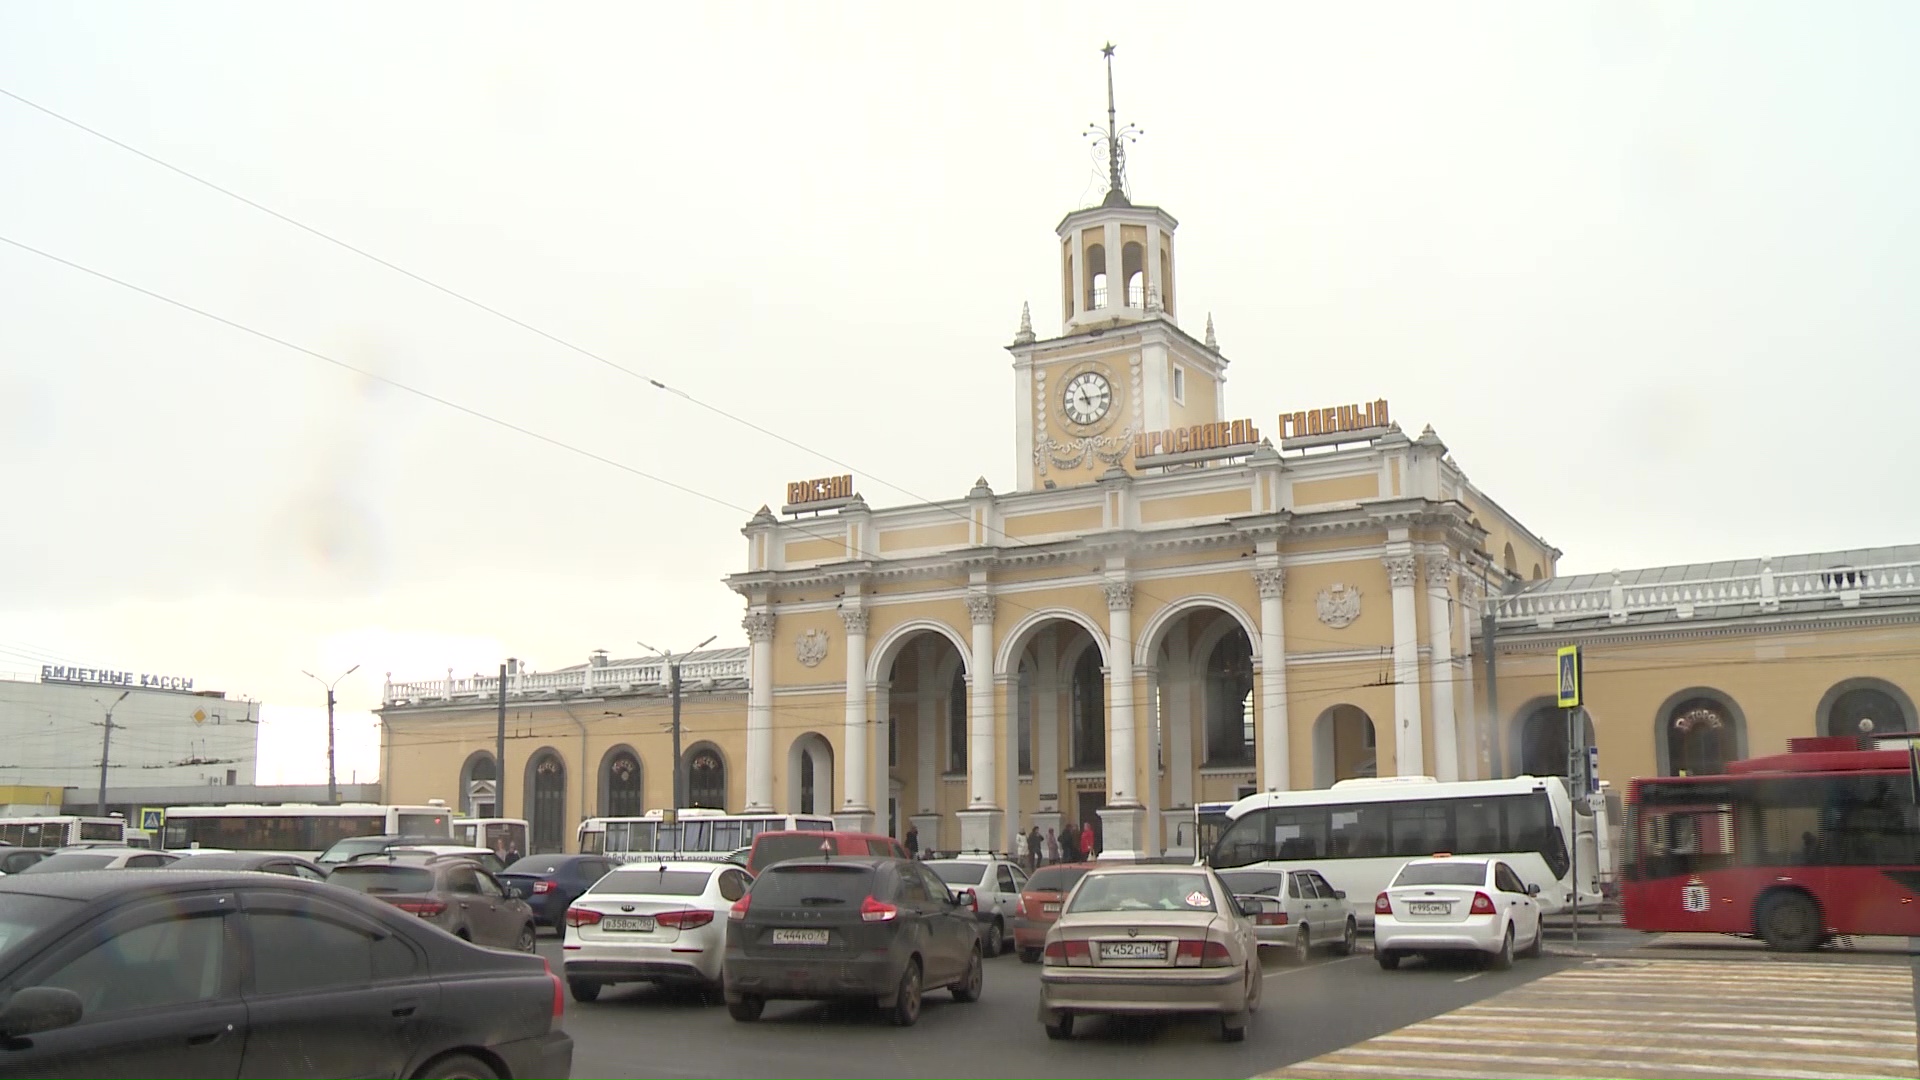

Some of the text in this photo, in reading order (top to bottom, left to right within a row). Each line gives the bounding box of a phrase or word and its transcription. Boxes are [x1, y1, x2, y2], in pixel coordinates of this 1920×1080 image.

[1134, 400, 1389, 459] ЯРОСЛАВЛЬ ГЛАВНЫЙ
[787, 474, 853, 505] ВОКЗАЛ
[42, 665, 193, 689] БИЛЕТНЫЕ КАССЫ
[1105, 943, 1149, 955] К452СН
